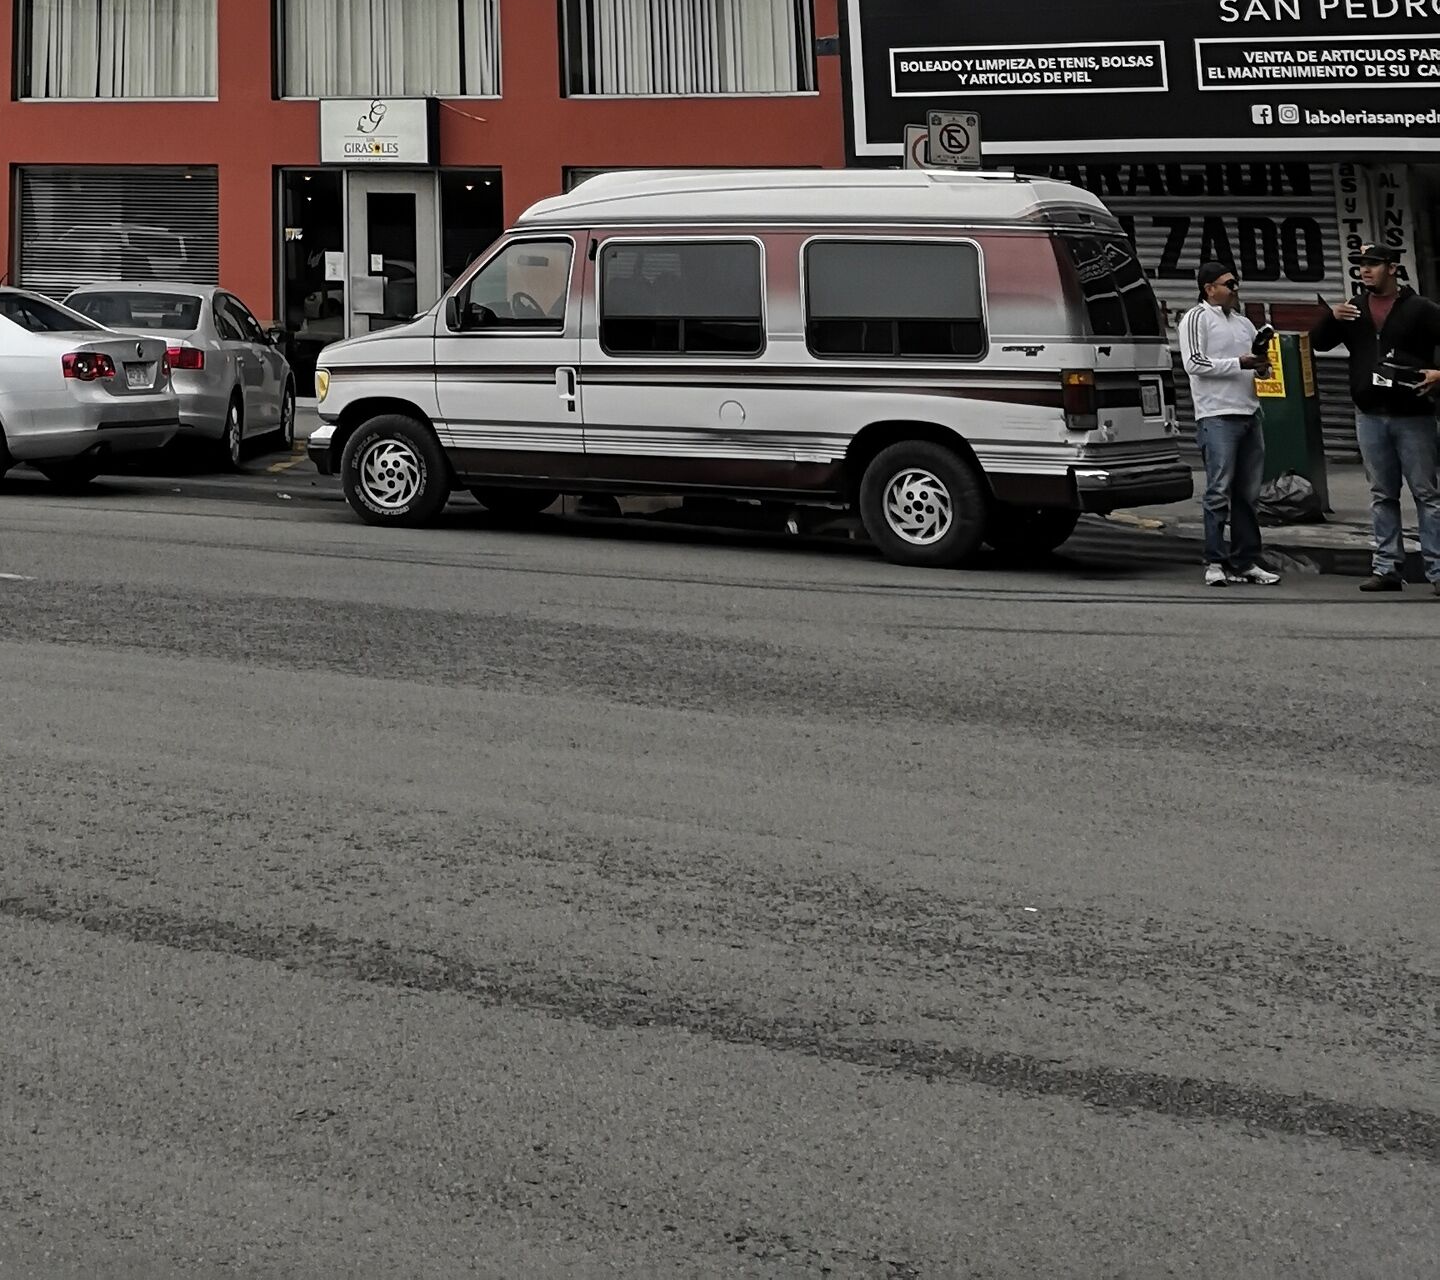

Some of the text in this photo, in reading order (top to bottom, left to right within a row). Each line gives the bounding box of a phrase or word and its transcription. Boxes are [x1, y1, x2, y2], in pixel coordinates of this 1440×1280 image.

[1242, 50, 1294, 63] VENTA
[1296, 50, 1318, 63] DE
[1321, 49, 1407, 62] ARTICULOS
[900, 56, 1154, 72] BOLEADO Y LIMPIEZA DE TENIS, BOLSAS
[958, 71, 1092, 85] Y ARTICULOS DE PIEL
[1207, 66, 1226, 79] EL
[1227, 65, 1358, 78] MANTENIMIENTO
[1364, 65, 1386, 77] DE
[1389, 64, 1410, 77] SU
